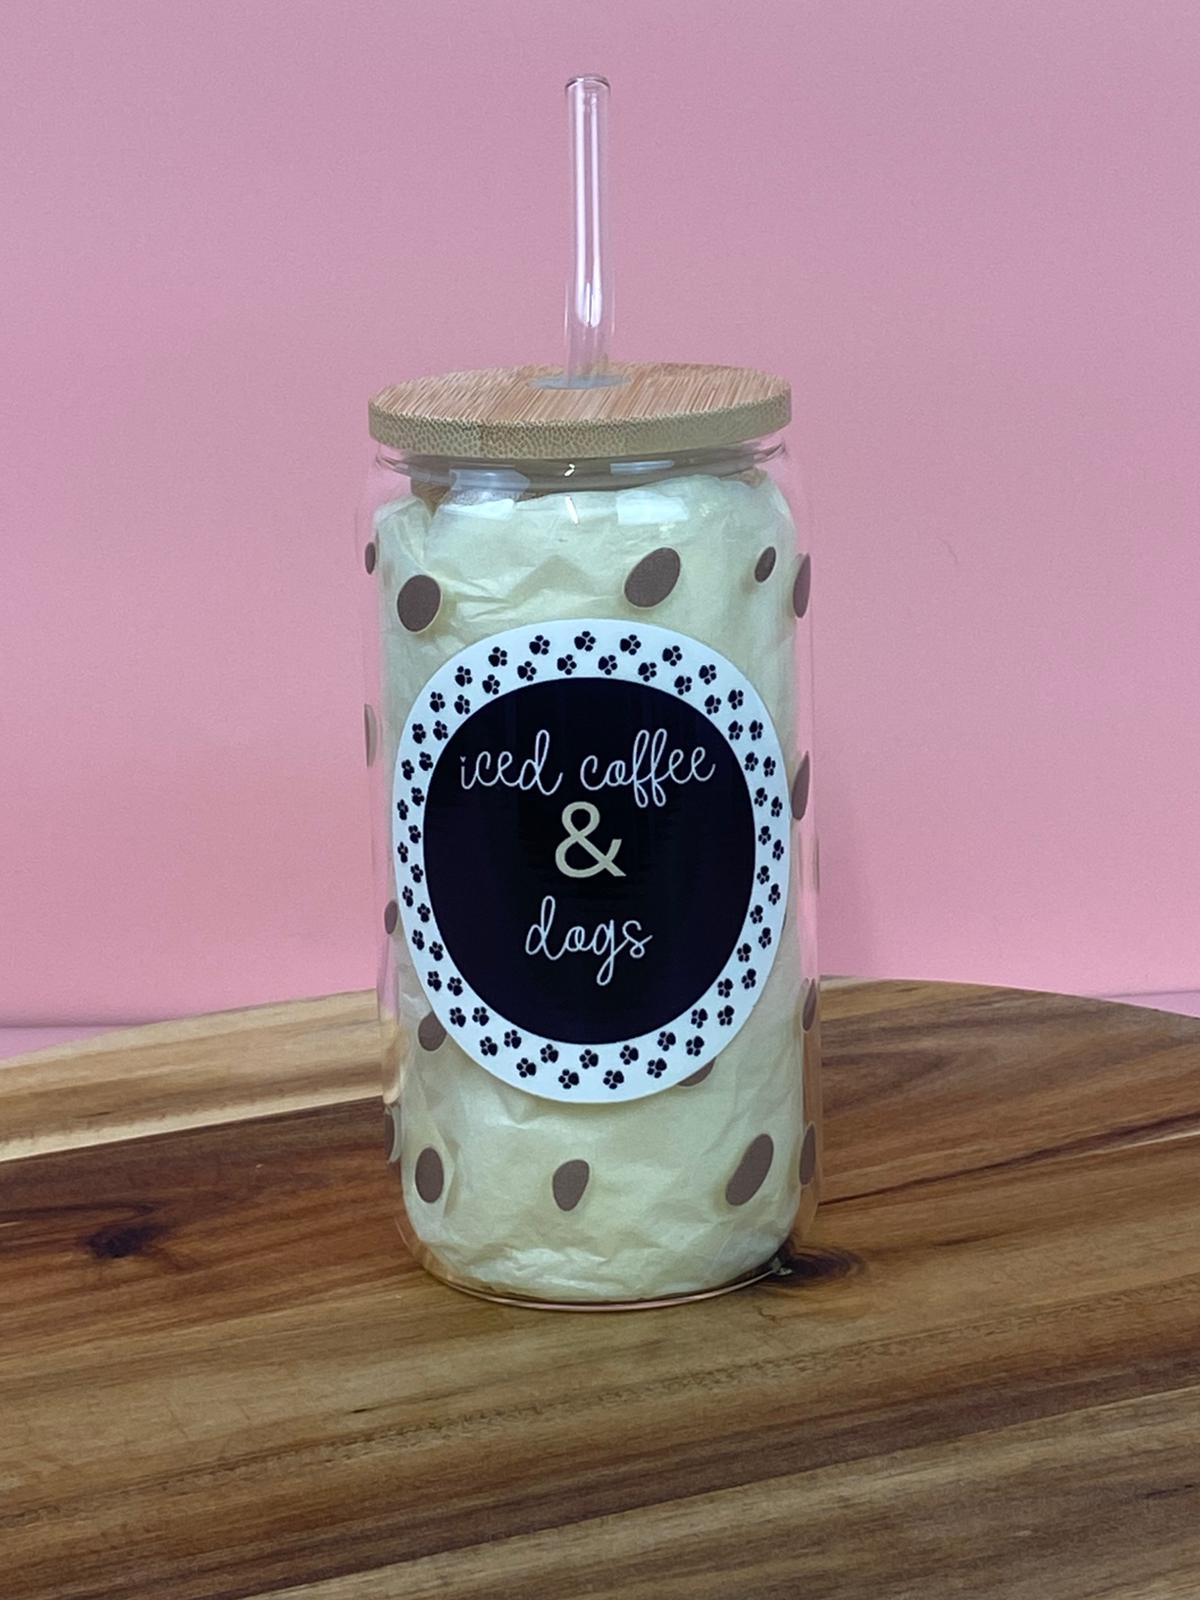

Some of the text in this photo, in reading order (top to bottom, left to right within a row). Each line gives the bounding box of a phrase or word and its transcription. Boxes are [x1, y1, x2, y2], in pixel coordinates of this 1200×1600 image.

[460, 728, 716, 808] iced coffee
[555, 801, 627, 878] &
[525, 895, 653, 986] dogs
